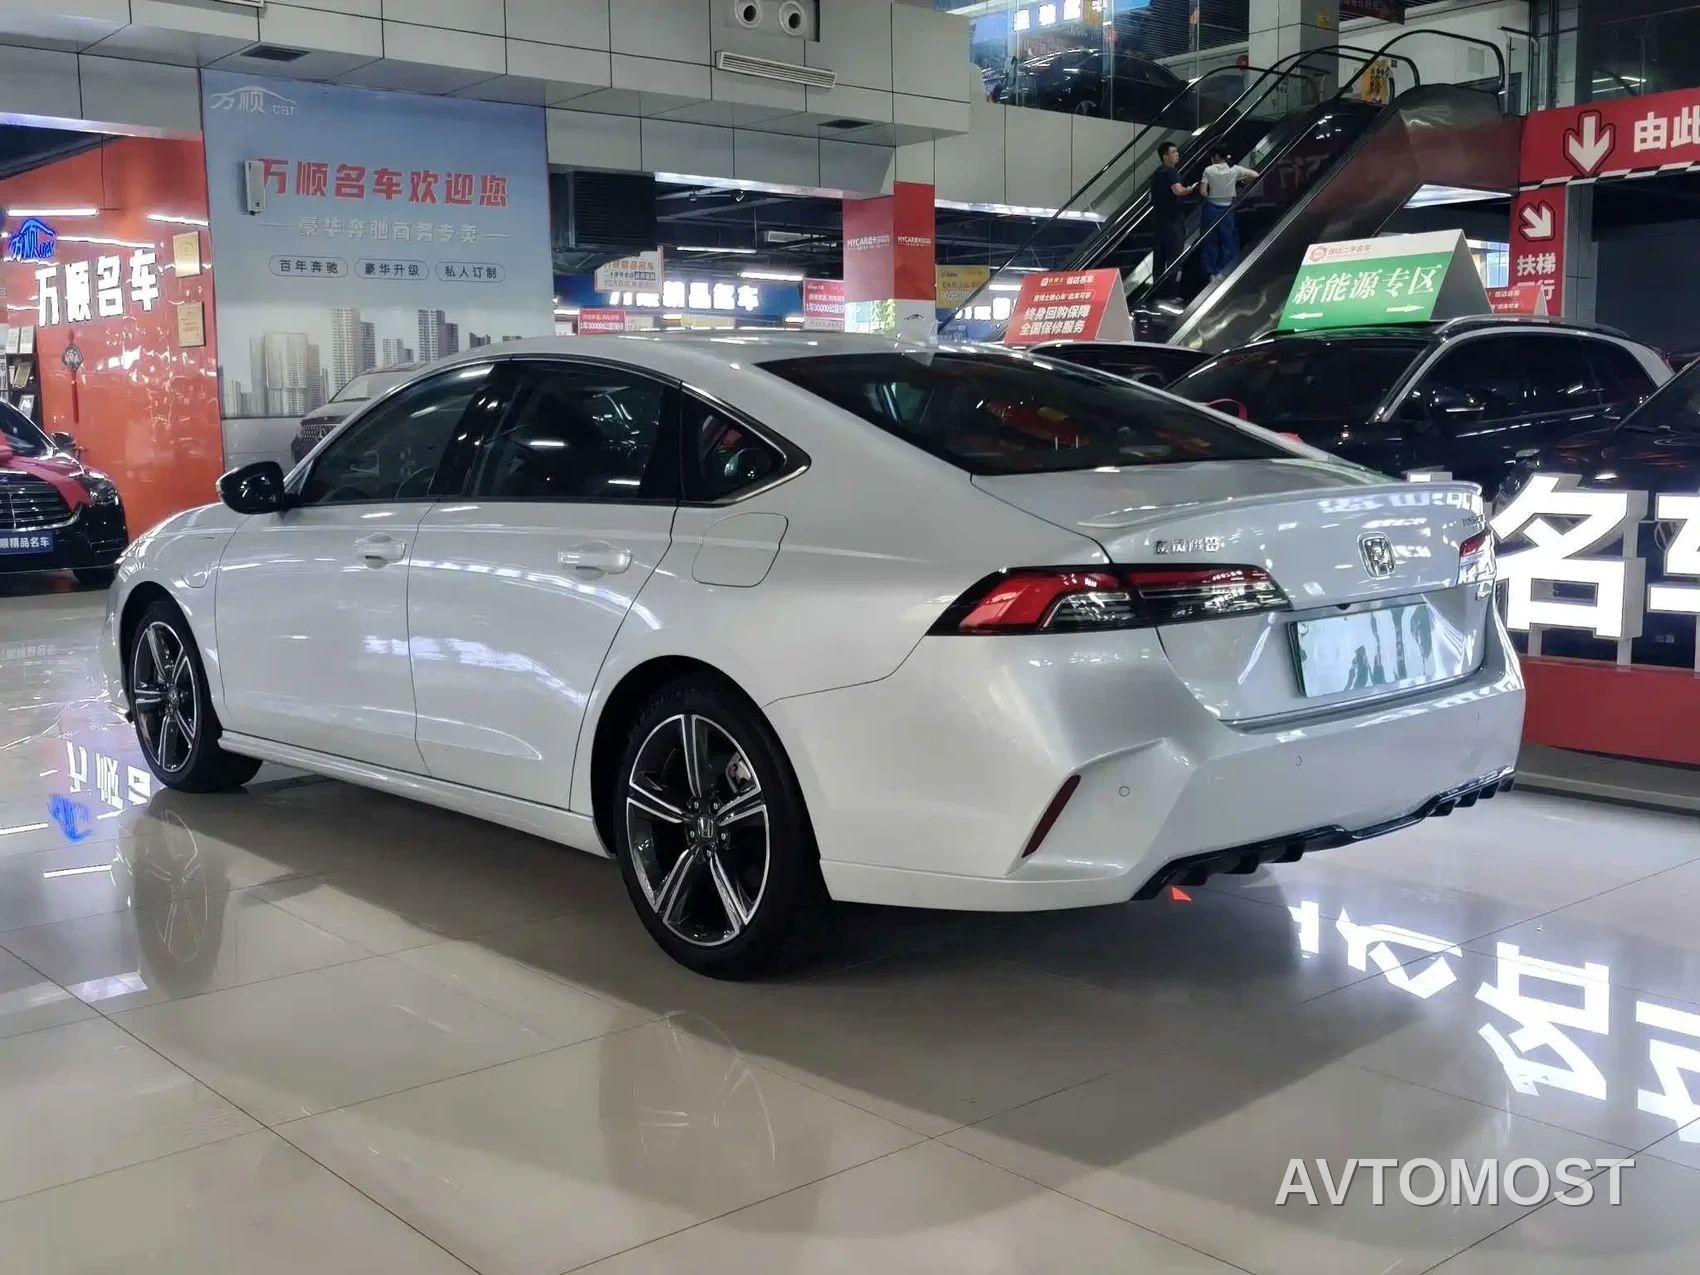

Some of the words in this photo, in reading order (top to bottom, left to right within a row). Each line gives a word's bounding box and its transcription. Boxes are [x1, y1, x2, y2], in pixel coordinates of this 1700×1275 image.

[260, 158, 509, 207] 万顺名车欢迎您
[279, 259, 339, 275] 百年奔驰
[364, 262, 420, 278] 豪华升级
[445, 265, 498, 280] 私人订制
[1517, 252, 1556, 276] 扶梯
[35, 249, 159, 327] 万顺名车
[1292, 265, 1443, 305] 新能源专区
[1517, 279, 1555, 300] 行
[1024, 304, 1091, 320] 终身回购保障
[1019, 320, 1085, 336] 全国保修服务
